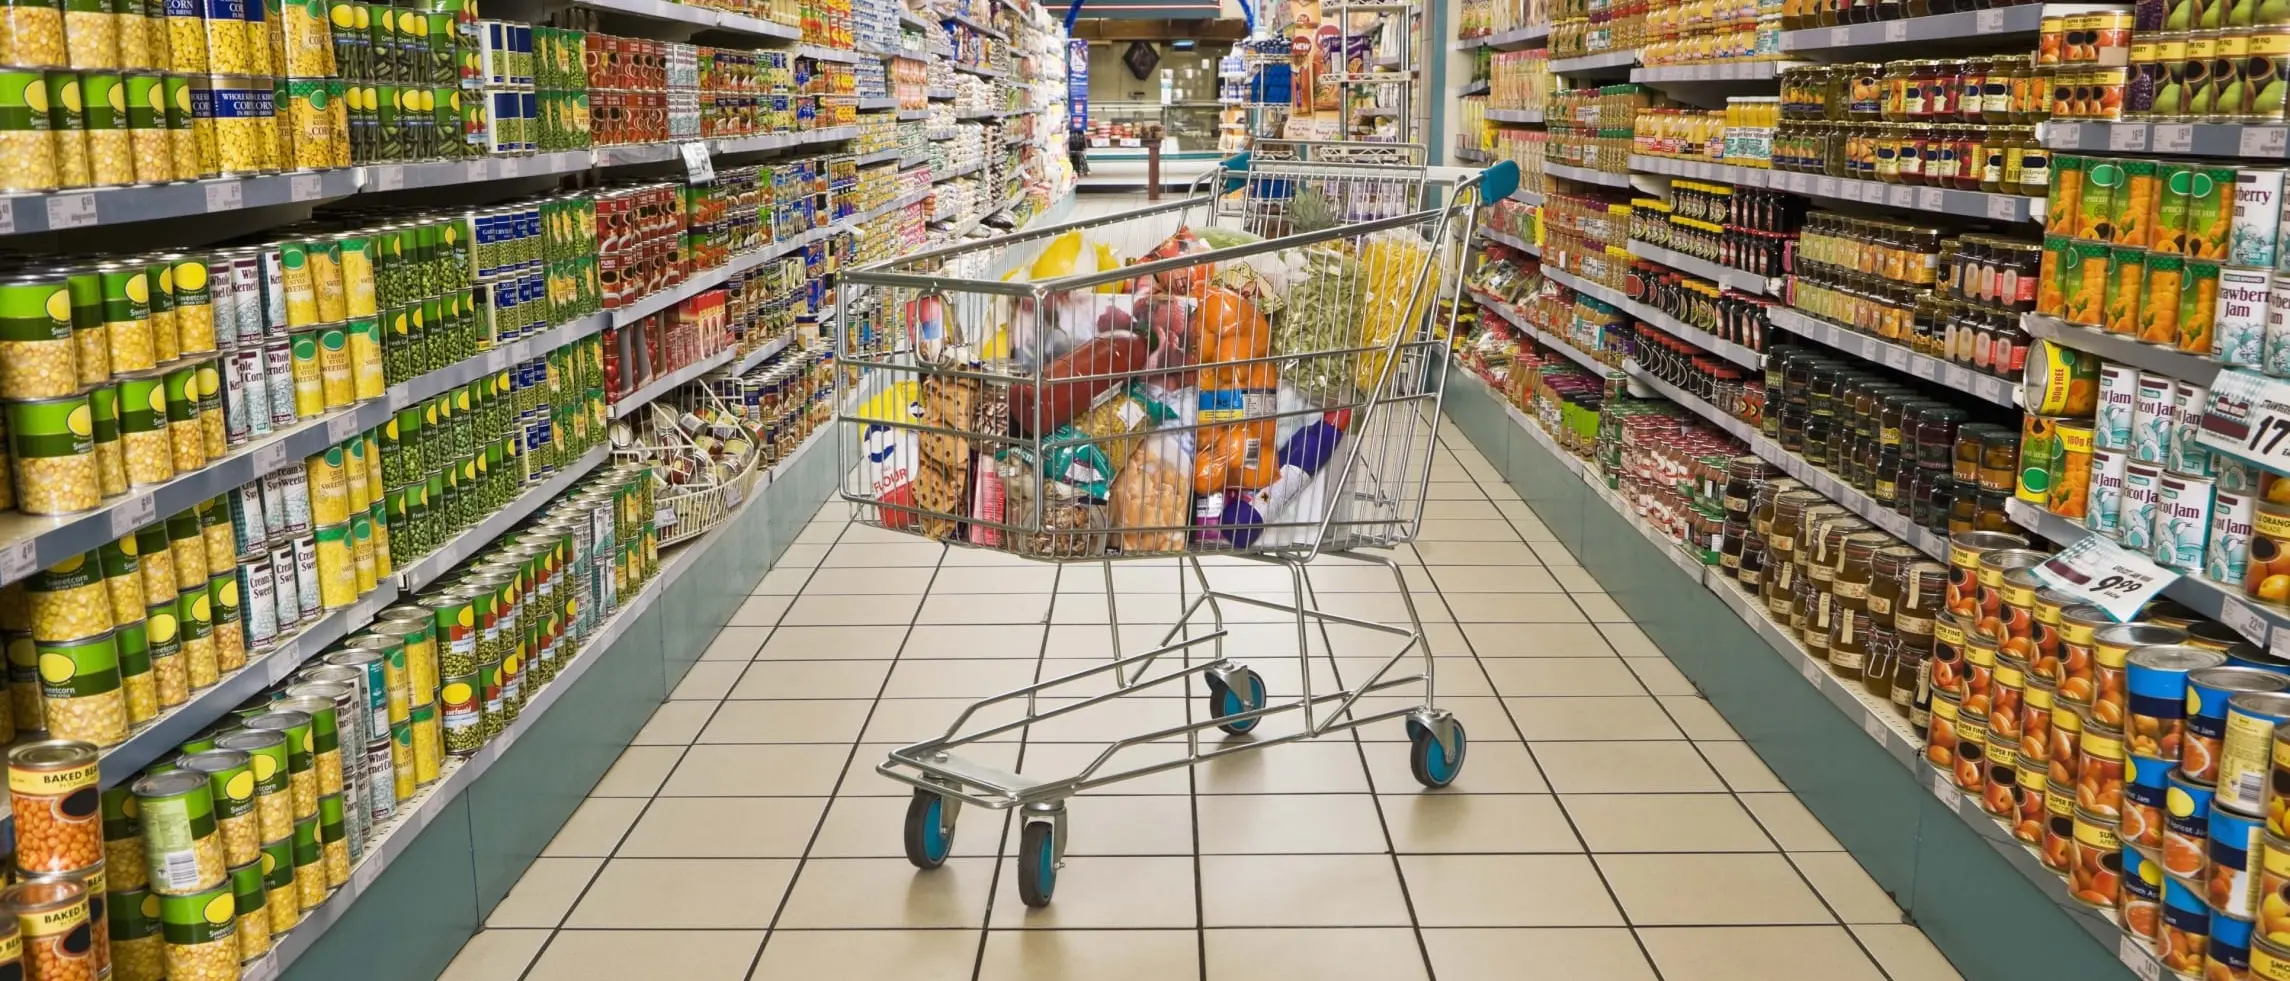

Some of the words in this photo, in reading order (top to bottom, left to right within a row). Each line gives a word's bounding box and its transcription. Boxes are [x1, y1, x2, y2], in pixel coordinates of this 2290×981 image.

[1292, 42, 1311, 51] NEW
[209, 274, 230, 287] Whole
[2224, 302, 2251, 318] Jam
[2054, 368, 2064, 386] FREE
[2109, 389, 2132, 405] Jam
[2067, 435, 2085, 447] 100g
[2248, 415, 2290, 455] 17
[873, 468, 908, 493] FLOUR
[2099, 473, 2121, 488] Jam
[2145, 489, 2159, 504] Ja
[2173, 504, 2200, 519] Jam
[2226, 518, 2251, 536] Jam
[298, 550, 315, 562] Crea
[276, 563, 293, 576] Crea
[301, 560, 316, 572] Swee
[280, 573, 294, 585] Swee
[1959, 723, 1972, 732] SUPER
[2201, 725, 2216, 737] Jam
[1990, 745, 2006, 755] SUPER
[367, 752, 389, 764] Whole
[43, 771, 82, 784] BAKED
[2049, 796, 2066, 807] SUPER
[2136, 794, 2150, 804] Jam
[44, 907, 81, 924] BAKED
